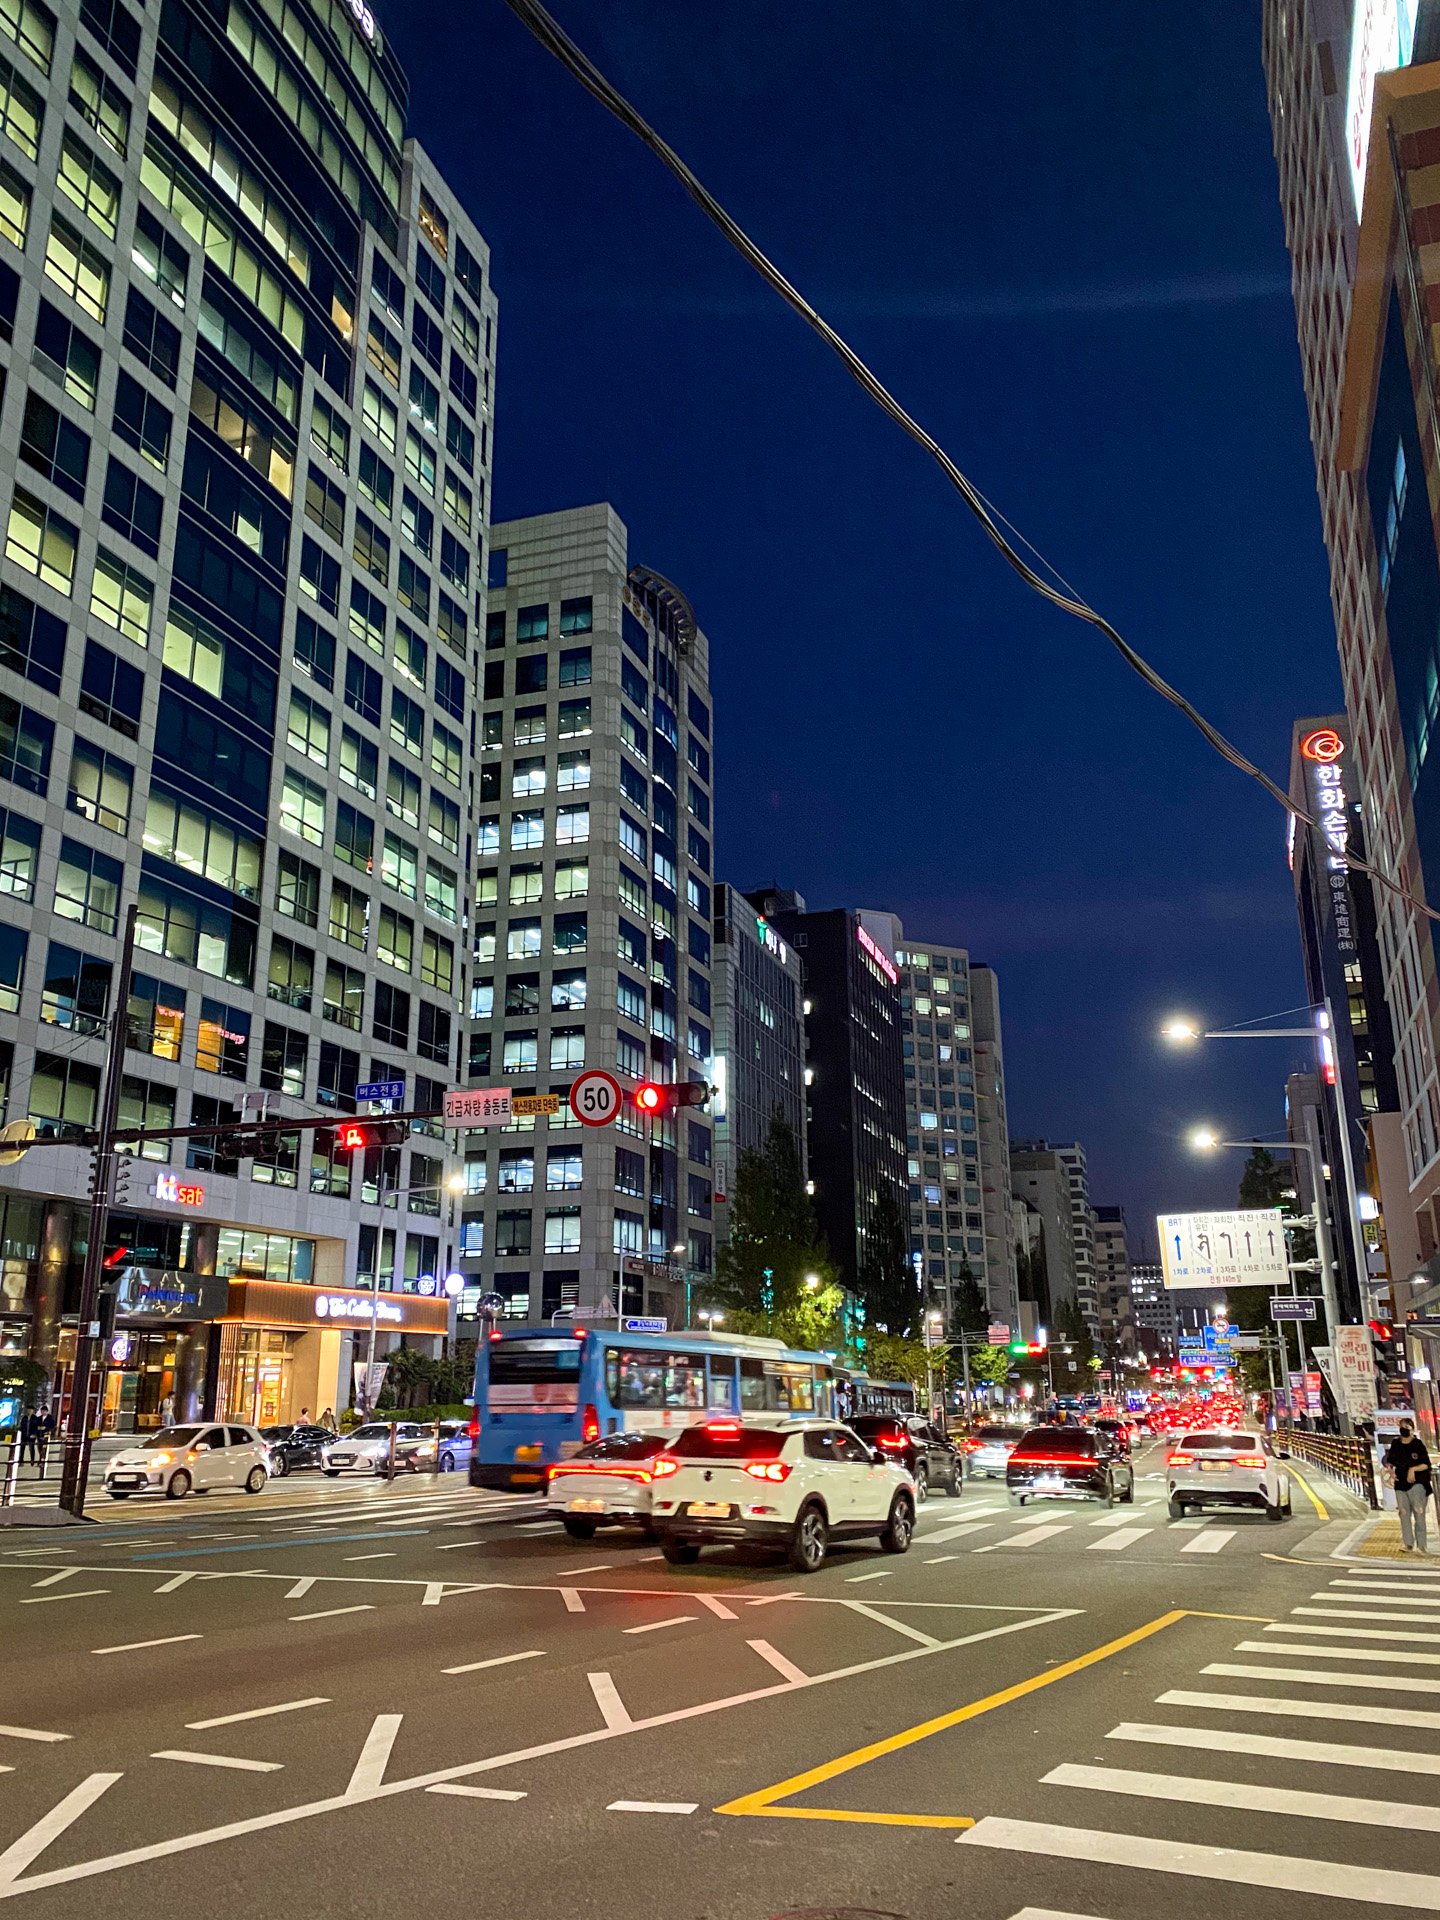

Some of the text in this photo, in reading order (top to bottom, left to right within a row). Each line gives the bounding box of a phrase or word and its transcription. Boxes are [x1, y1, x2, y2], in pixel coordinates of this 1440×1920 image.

[359, 1083, 400, 1098] 버스전용
[584, 1087, 610, 1112] 50
[446, 1097, 510, 1119] 긴급차량 출동로
[156, 1173, 203, 1206] kt sat
[1213, 1215, 1233, 1223] 좌회전
[1238, 1214, 1254, 1222] 직진
[1261, 1212, 1277, 1221] 직진
[1168, 1218, 1182, 1226] BRT
[1196, 1266, 1212, 1274] 2차로
[1220, 1265, 1237, 1273] 3차로
[1243, 1264, 1260, 1272] 4차로
[1266, 1263, 1283, 1271] 5차로
